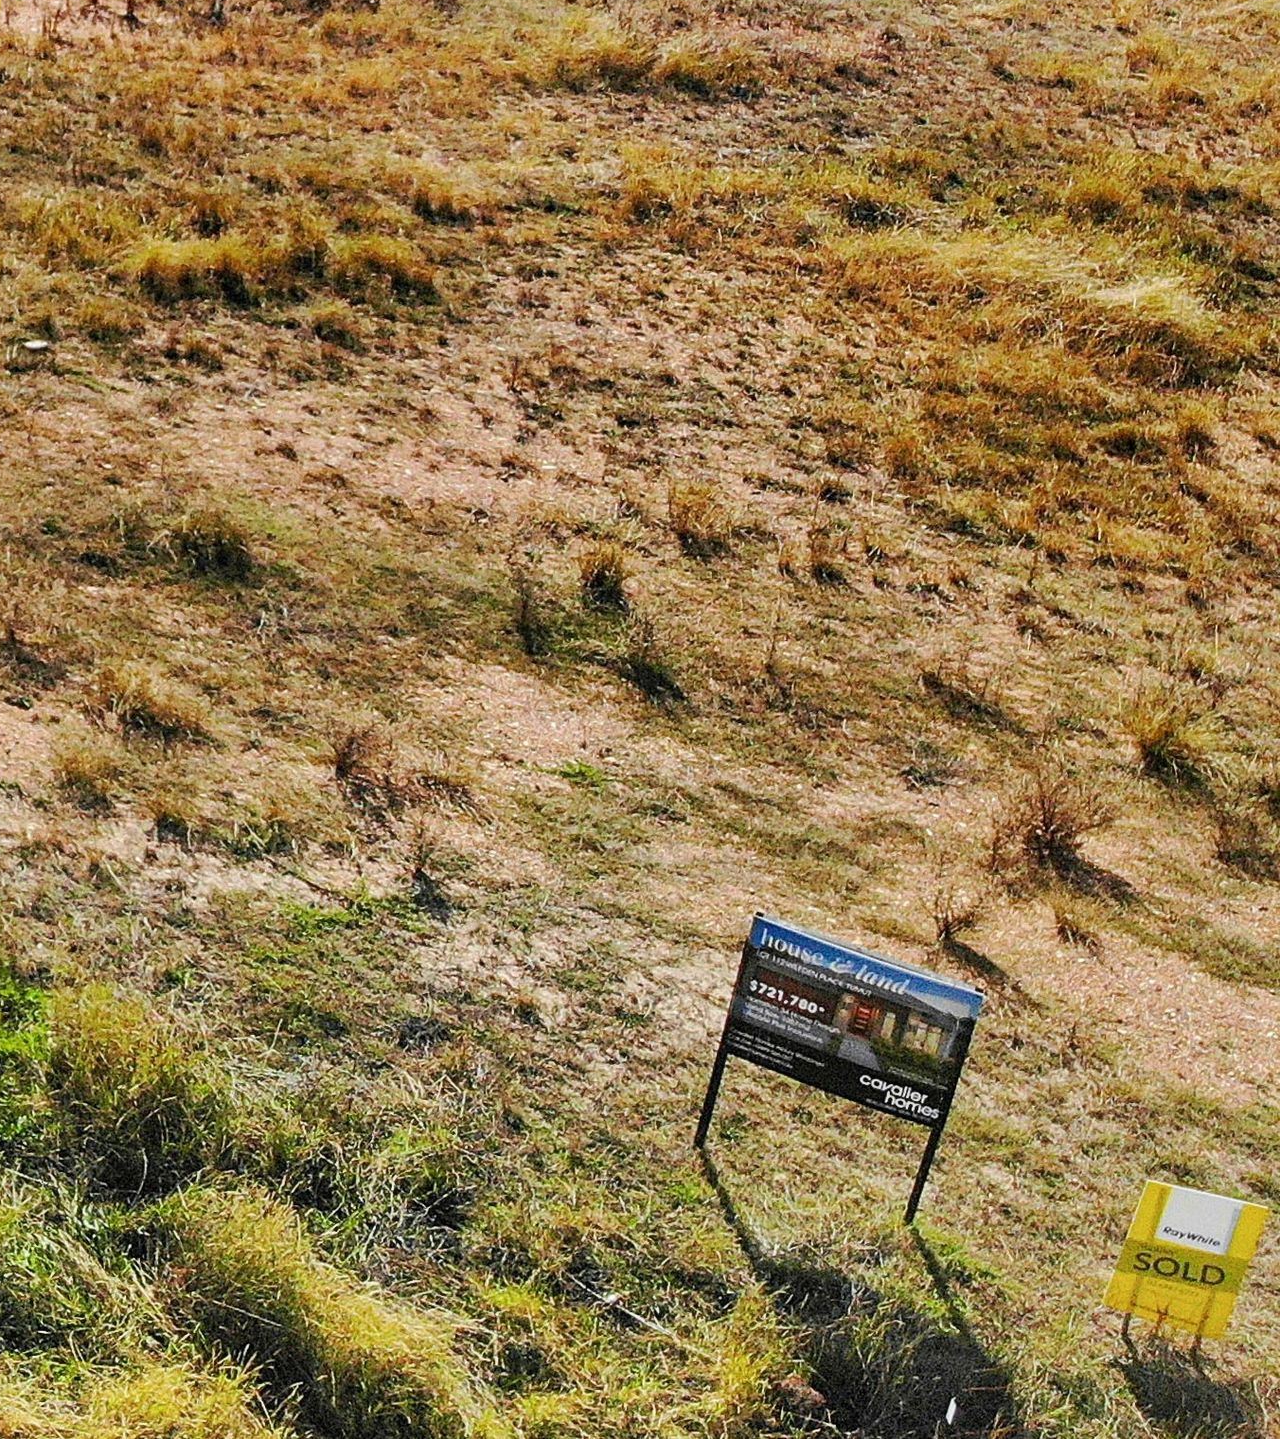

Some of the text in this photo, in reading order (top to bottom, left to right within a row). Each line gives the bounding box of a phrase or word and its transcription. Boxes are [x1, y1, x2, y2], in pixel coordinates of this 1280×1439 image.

[760, 928, 825, 966] house
[855, 964, 910, 995] land
[859, 1074, 928, 1104] cavalier
[884, 1090, 940, 1119] homes
[1132, 1251, 1225, 1286] SOLD
